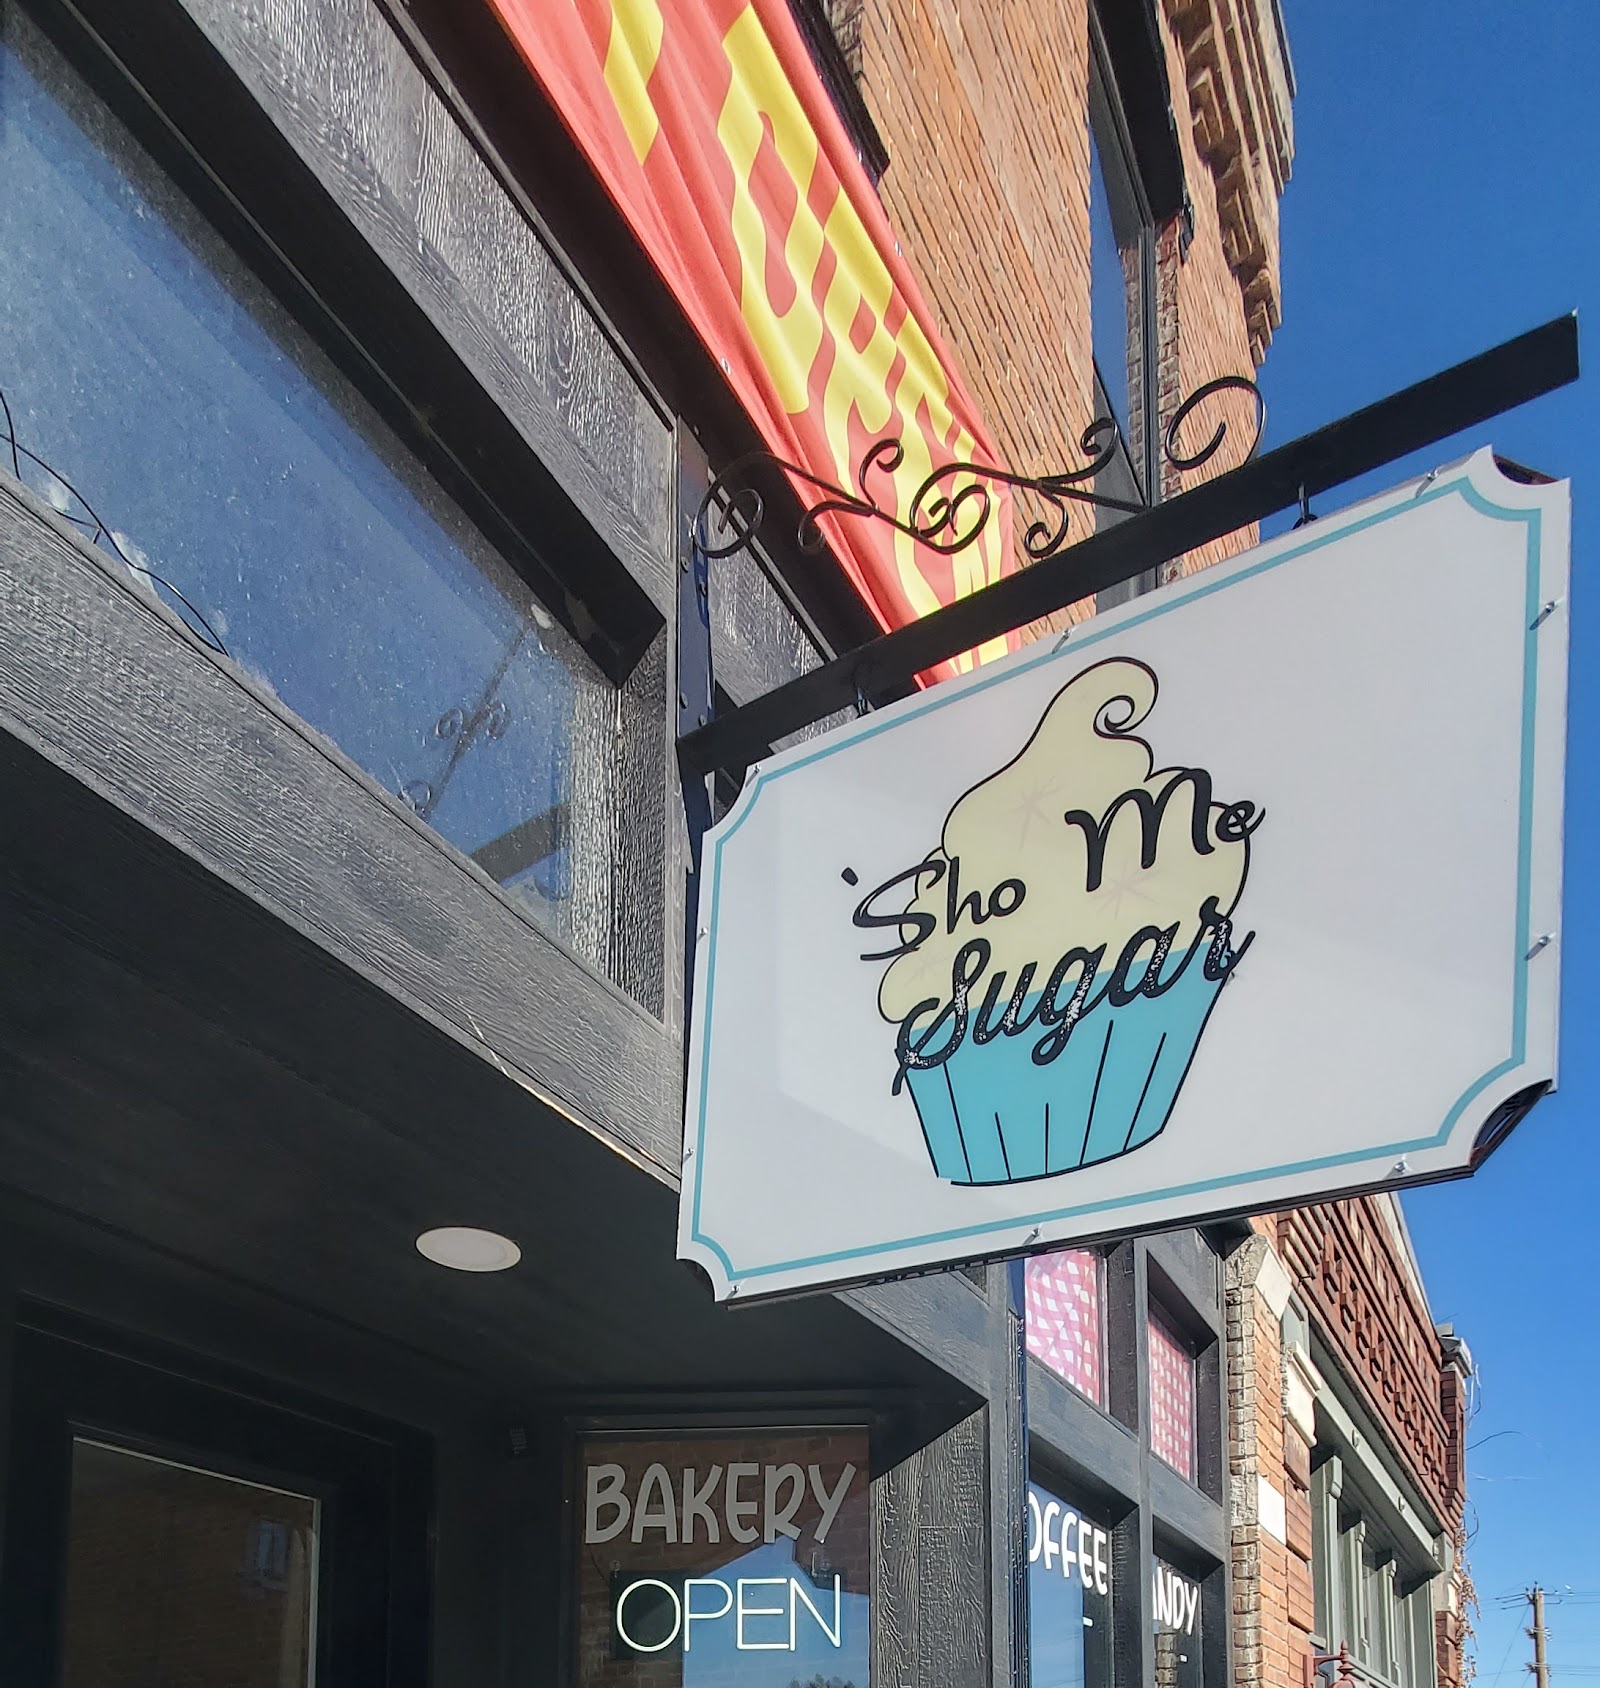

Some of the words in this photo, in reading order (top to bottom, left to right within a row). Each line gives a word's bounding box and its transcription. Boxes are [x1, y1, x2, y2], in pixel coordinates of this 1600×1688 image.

[1064, 768, 1266, 893] Me
[891, 895, 1256, 1097] Sugar
[585, 1462, 857, 1544] BAKERY
[616, 1573, 841, 1652] OPEN
